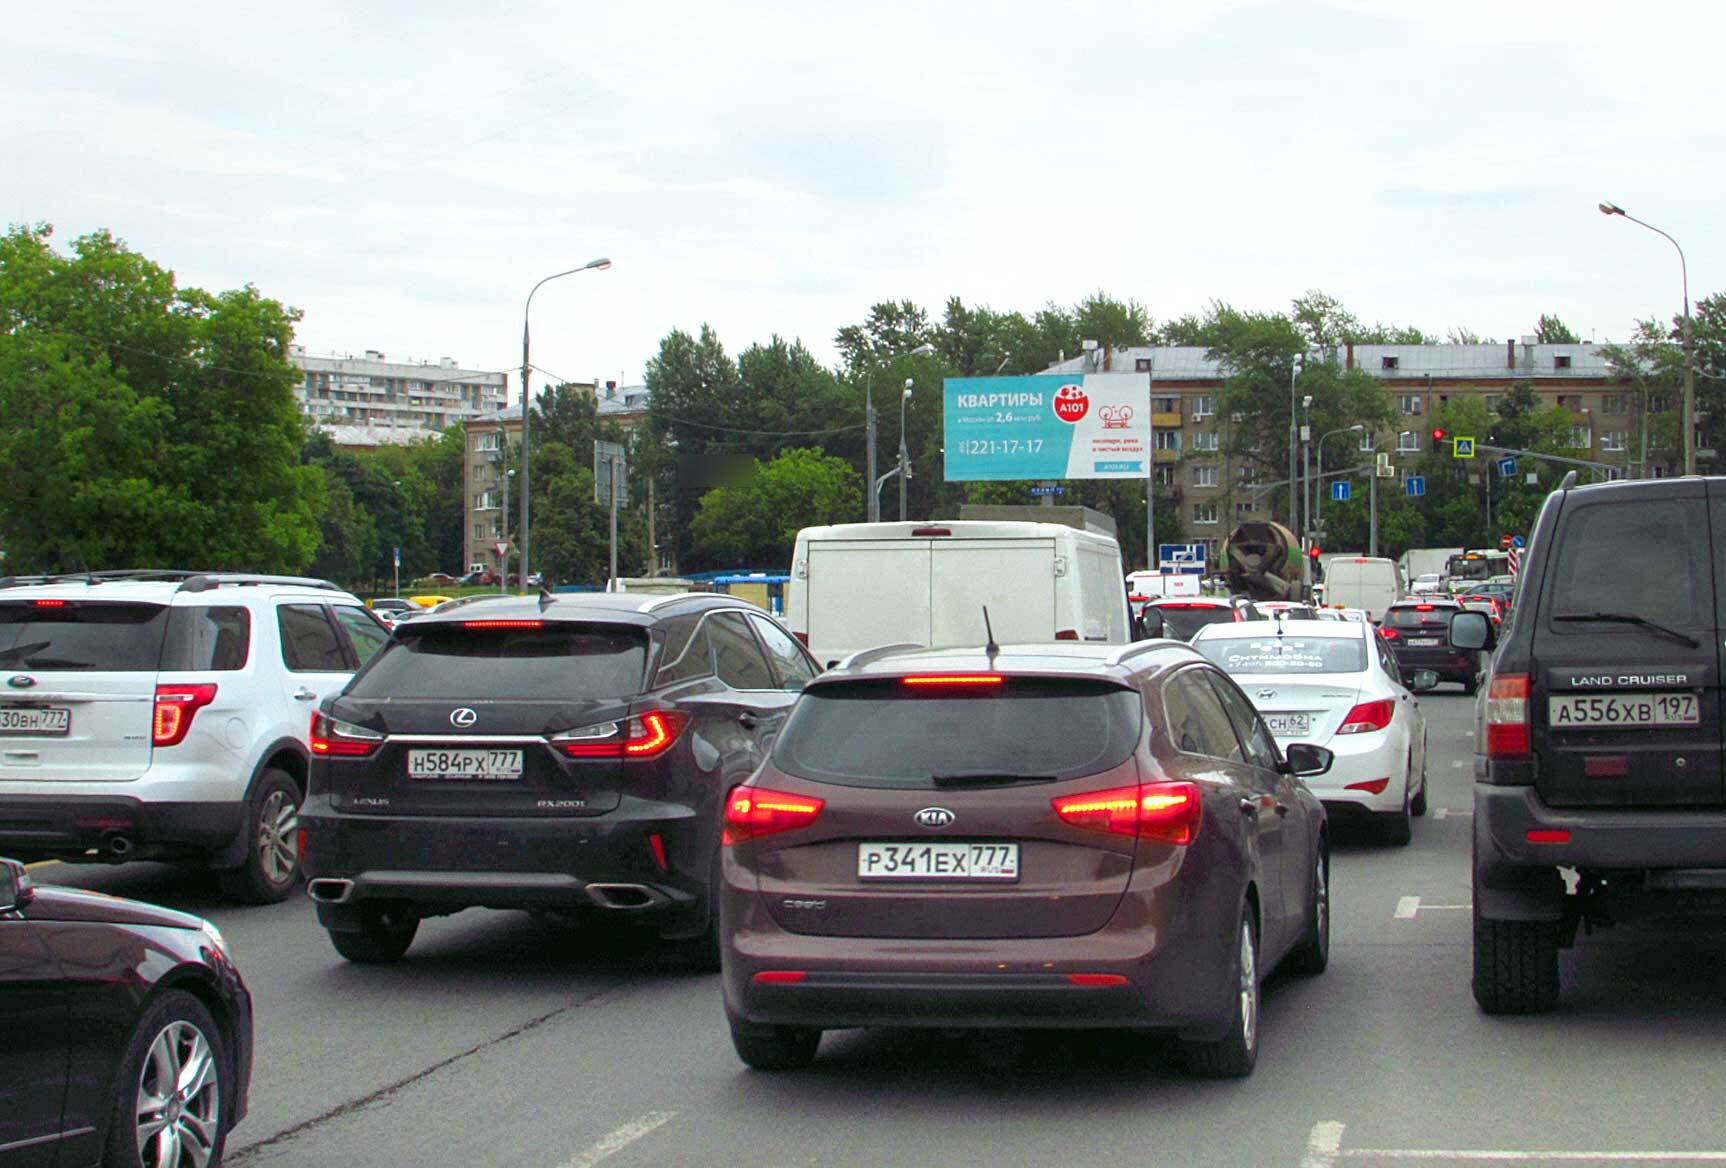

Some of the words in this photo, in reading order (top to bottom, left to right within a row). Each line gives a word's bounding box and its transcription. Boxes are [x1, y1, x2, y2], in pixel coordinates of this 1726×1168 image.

[957, 393, 1043, 409] КВАРТИРЫ
[995, 411, 1014, 424] 2,6
[970, 438, 1044, 455] 221-17-17
[1571, 676, 1613, 686] LAND
[1617, 674, 1688, 685] CRUISER
[1658, 696, 1695, 715] 197
[0, 711, 38, 728] 30ВН
[42, 711, 64, 724] 777
[1289, 715, 1304, 726] 62
[490, 752, 518, 767] 777
[919, 812, 949, 826] KIA
[972, 846, 1011, 866] 777
